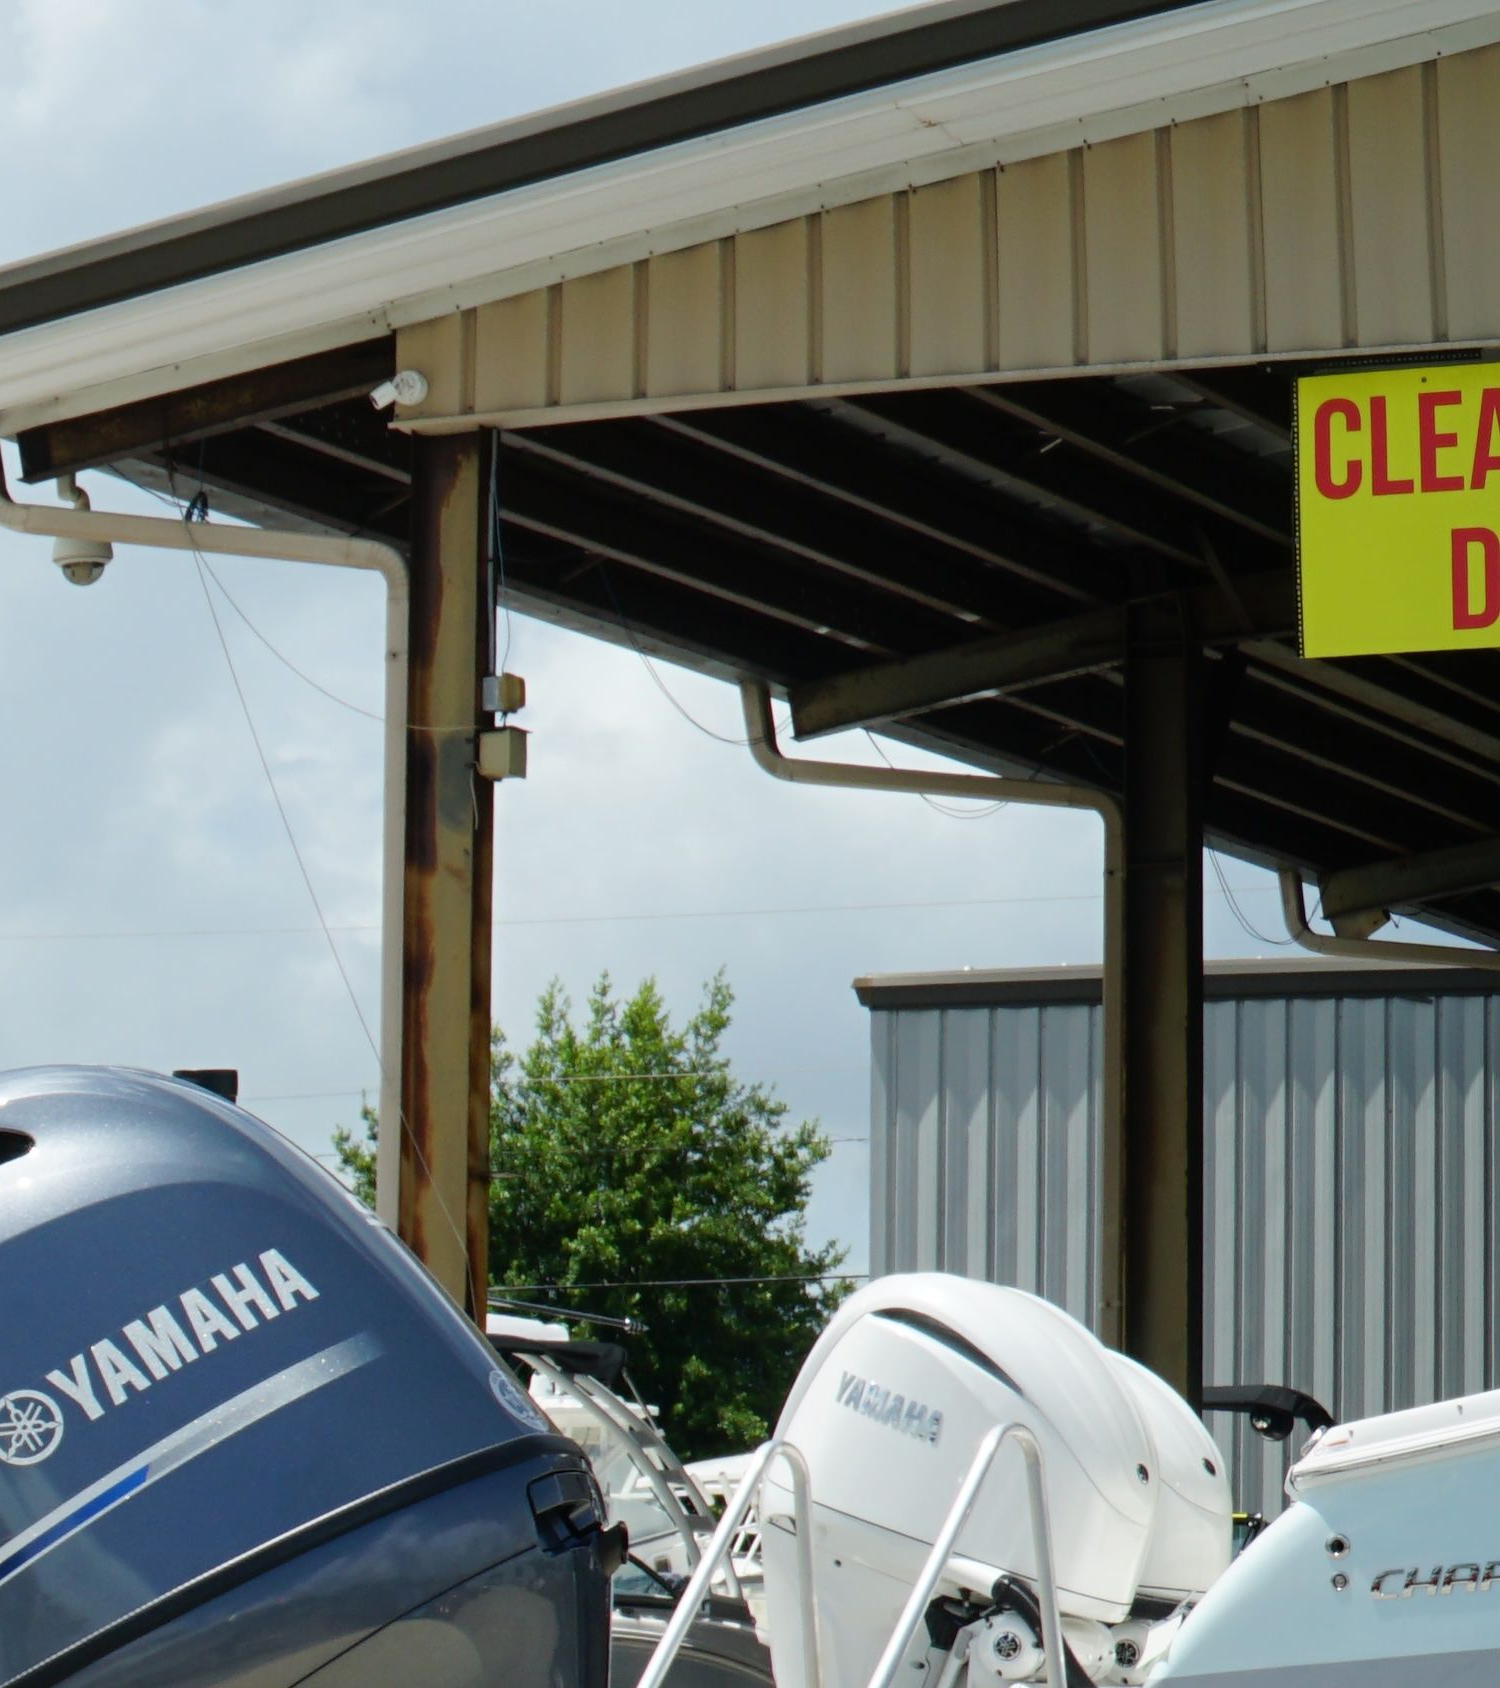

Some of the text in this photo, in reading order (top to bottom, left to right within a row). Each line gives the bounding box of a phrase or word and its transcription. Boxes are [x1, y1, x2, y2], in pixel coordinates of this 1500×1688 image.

[1314, 388, 1500, 500] CLEA
[1451, 527, 1500, 630] D
[45, 1247, 321, 1424] YAMAHA
[835, 1370, 944, 1447] YAMAHA
